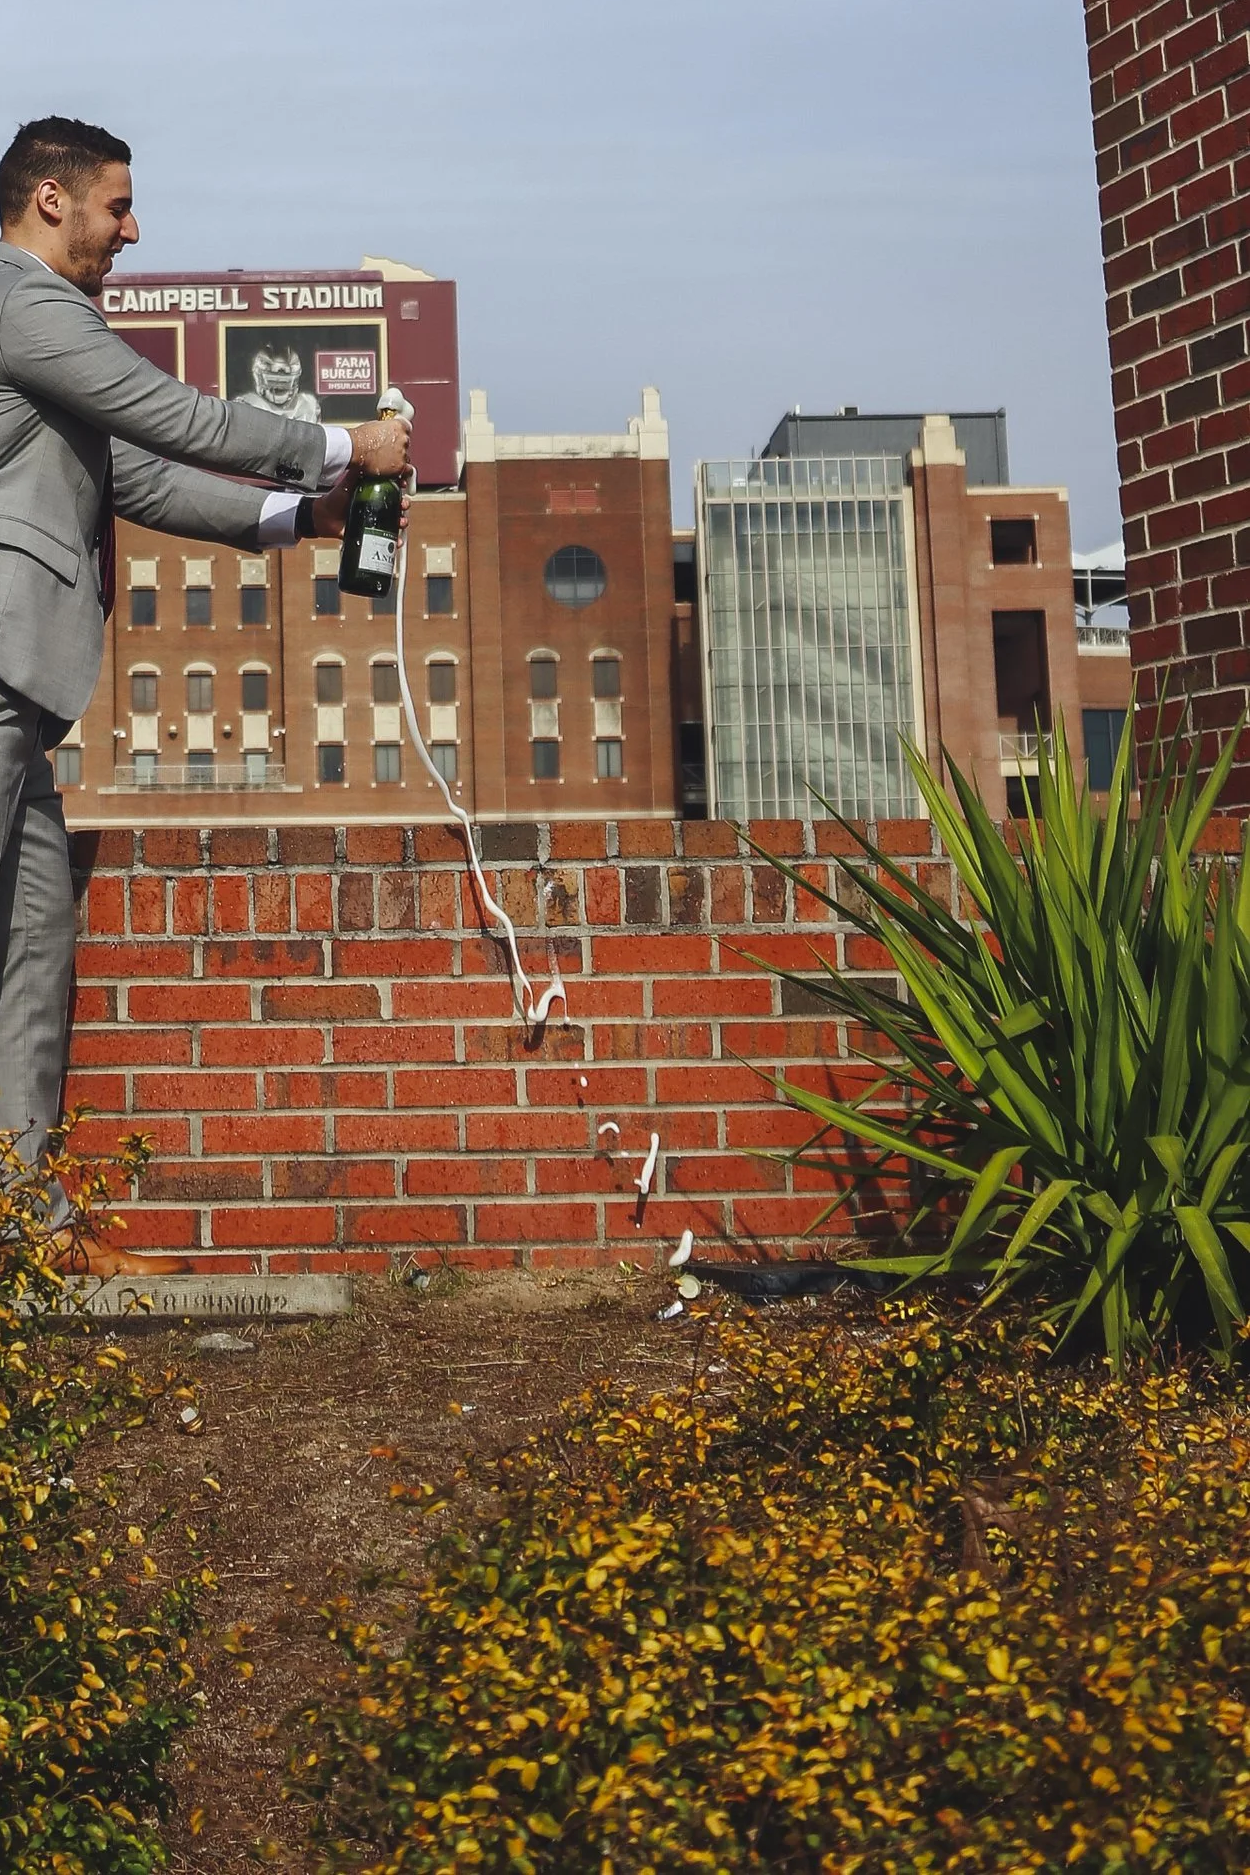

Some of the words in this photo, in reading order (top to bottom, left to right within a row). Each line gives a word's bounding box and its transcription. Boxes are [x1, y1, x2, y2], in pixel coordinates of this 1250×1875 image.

[102, 287, 249, 313] CAMPBELL
[262, 285, 384, 310] STADIUM
[335, 356, 370, 368] FARM
[321, 368, 371, 380] BUREAU
[328, 382, 371, 390] INSURANCE
